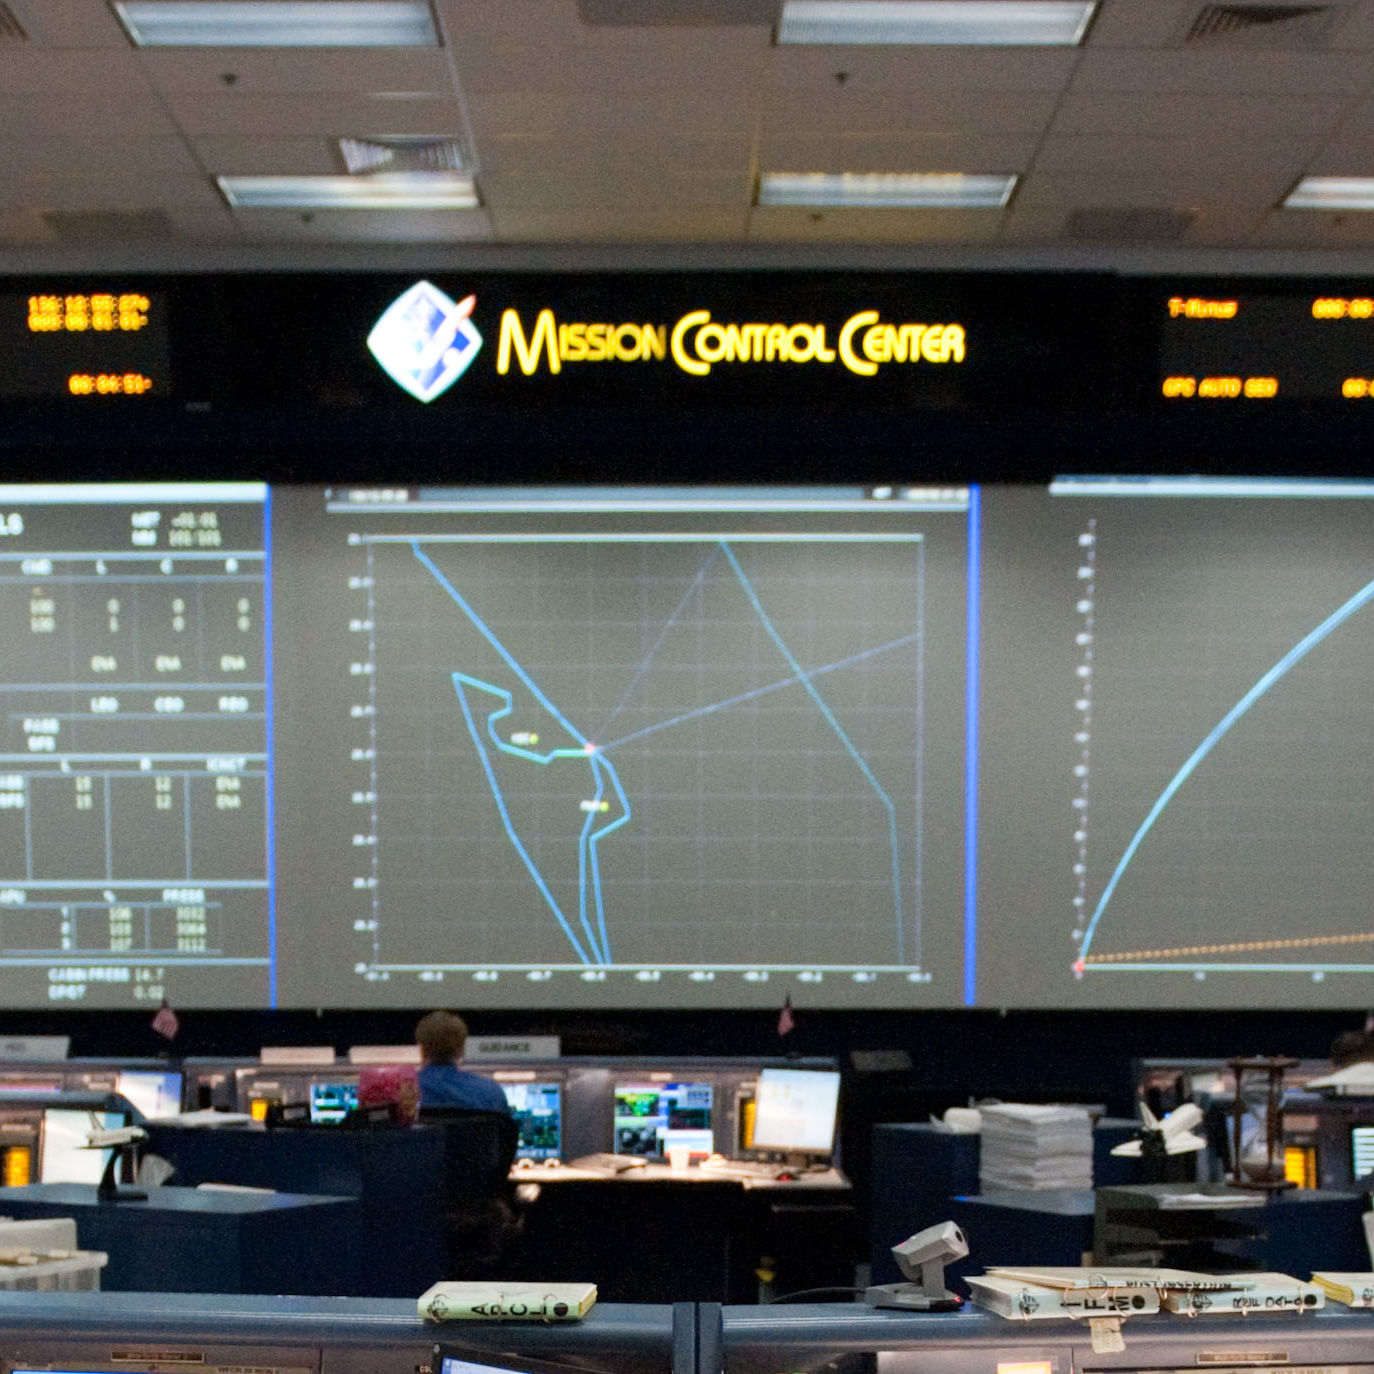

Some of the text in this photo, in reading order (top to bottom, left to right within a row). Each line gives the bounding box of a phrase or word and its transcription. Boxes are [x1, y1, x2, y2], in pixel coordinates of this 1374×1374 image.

[497, 309, 966, 376] MISSION CONTROL CENTER
